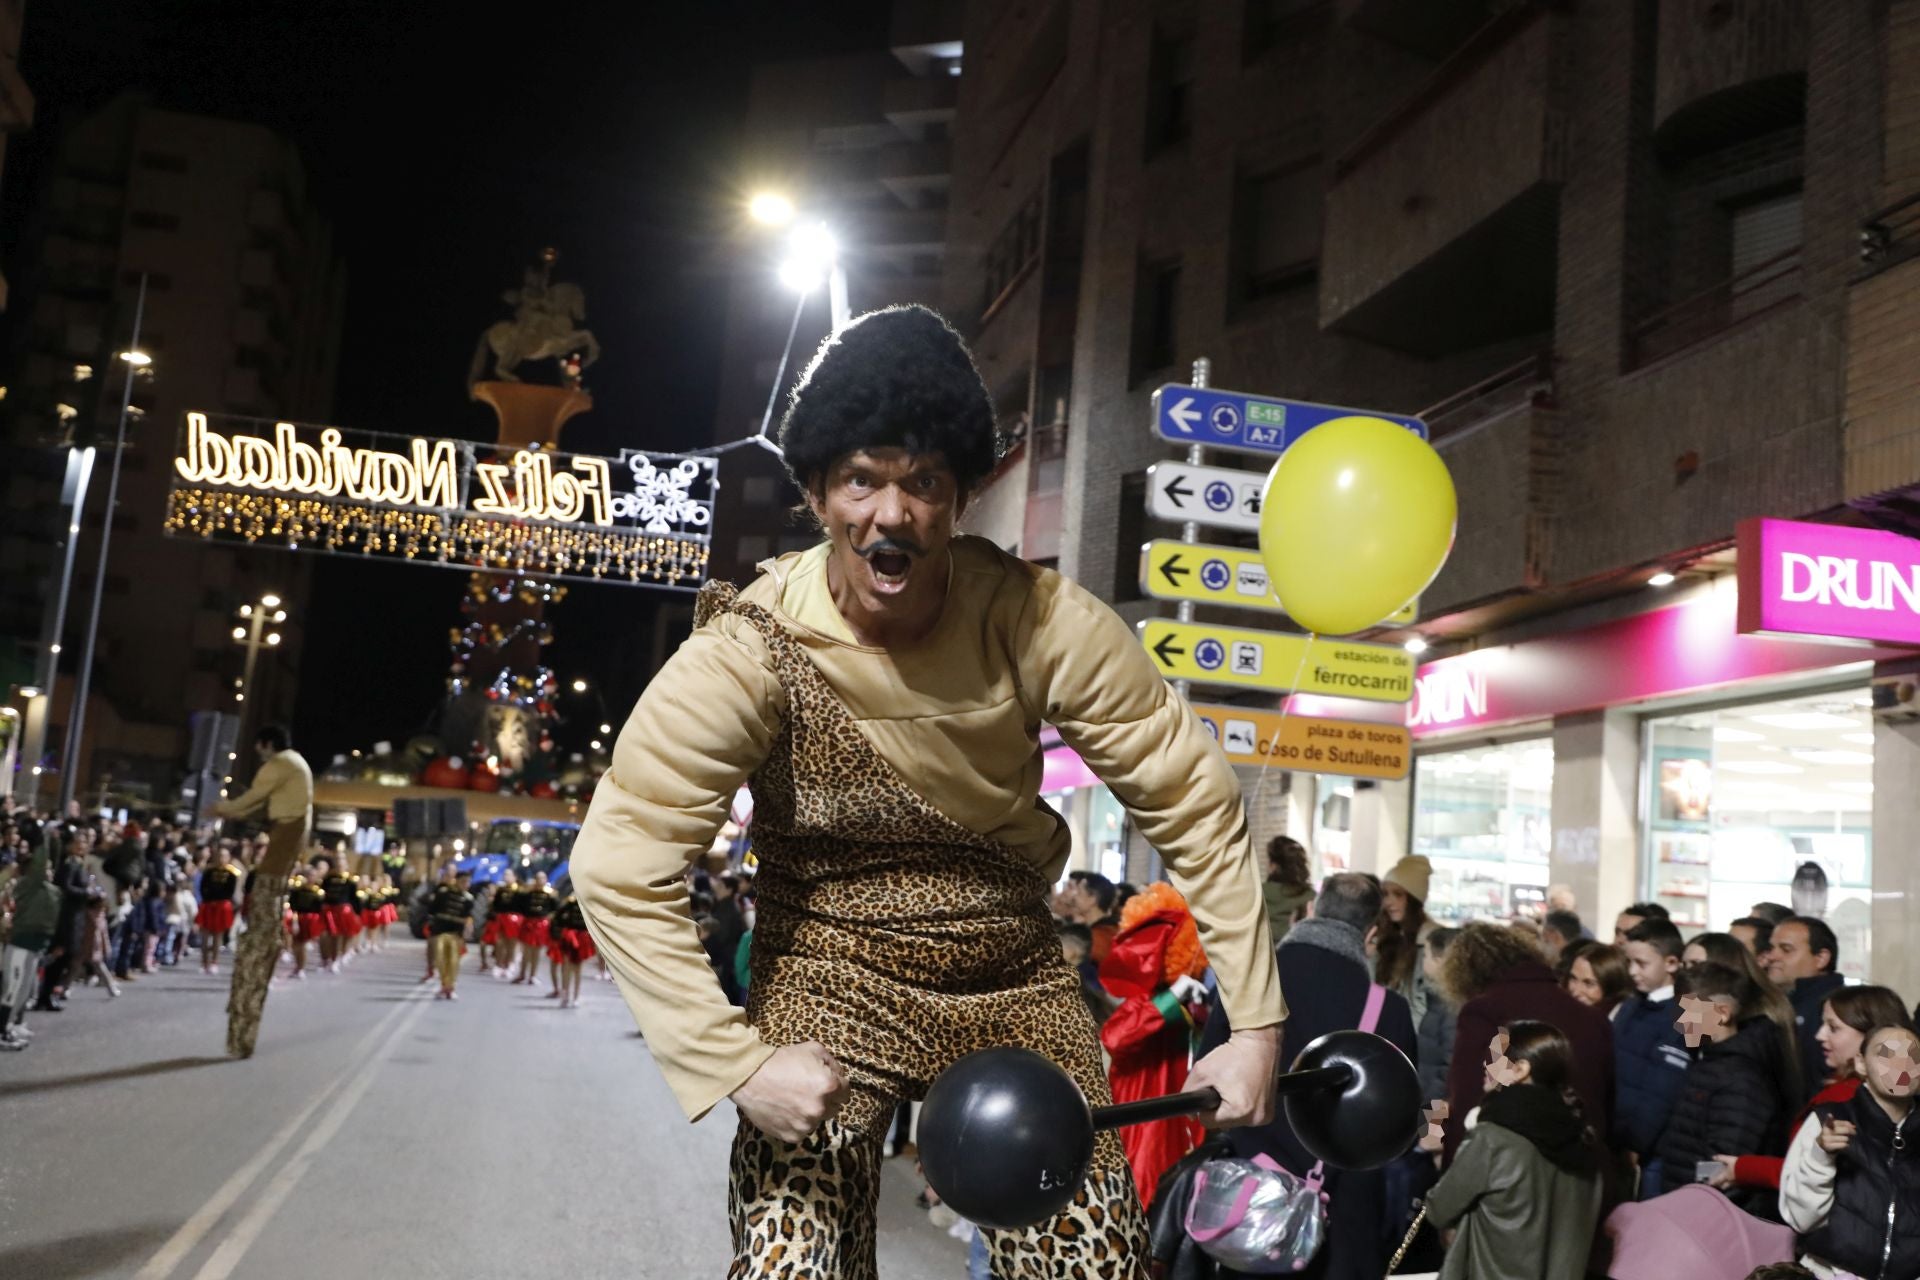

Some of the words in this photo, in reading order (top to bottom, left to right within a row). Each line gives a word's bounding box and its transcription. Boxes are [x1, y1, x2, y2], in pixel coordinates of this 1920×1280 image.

[1250, 405, 1281, 422] E-15
[1250, 427, 1278, 443] A-7
[1334, 650, 1389, 665] estación
[1392, 655, 1409, 667] de
[1314, 666, 1408, 692] ferrocarril
[1307, 723, 1343, 739] plaza
[1347, 727, 1365, 741] de
[1367, 730, 1403, 745] toros
[1258, 739, 1299, 759] Coso
[1303, 744, 1323, 762] de
[1328, 745, 1401, 769] Sutullena
